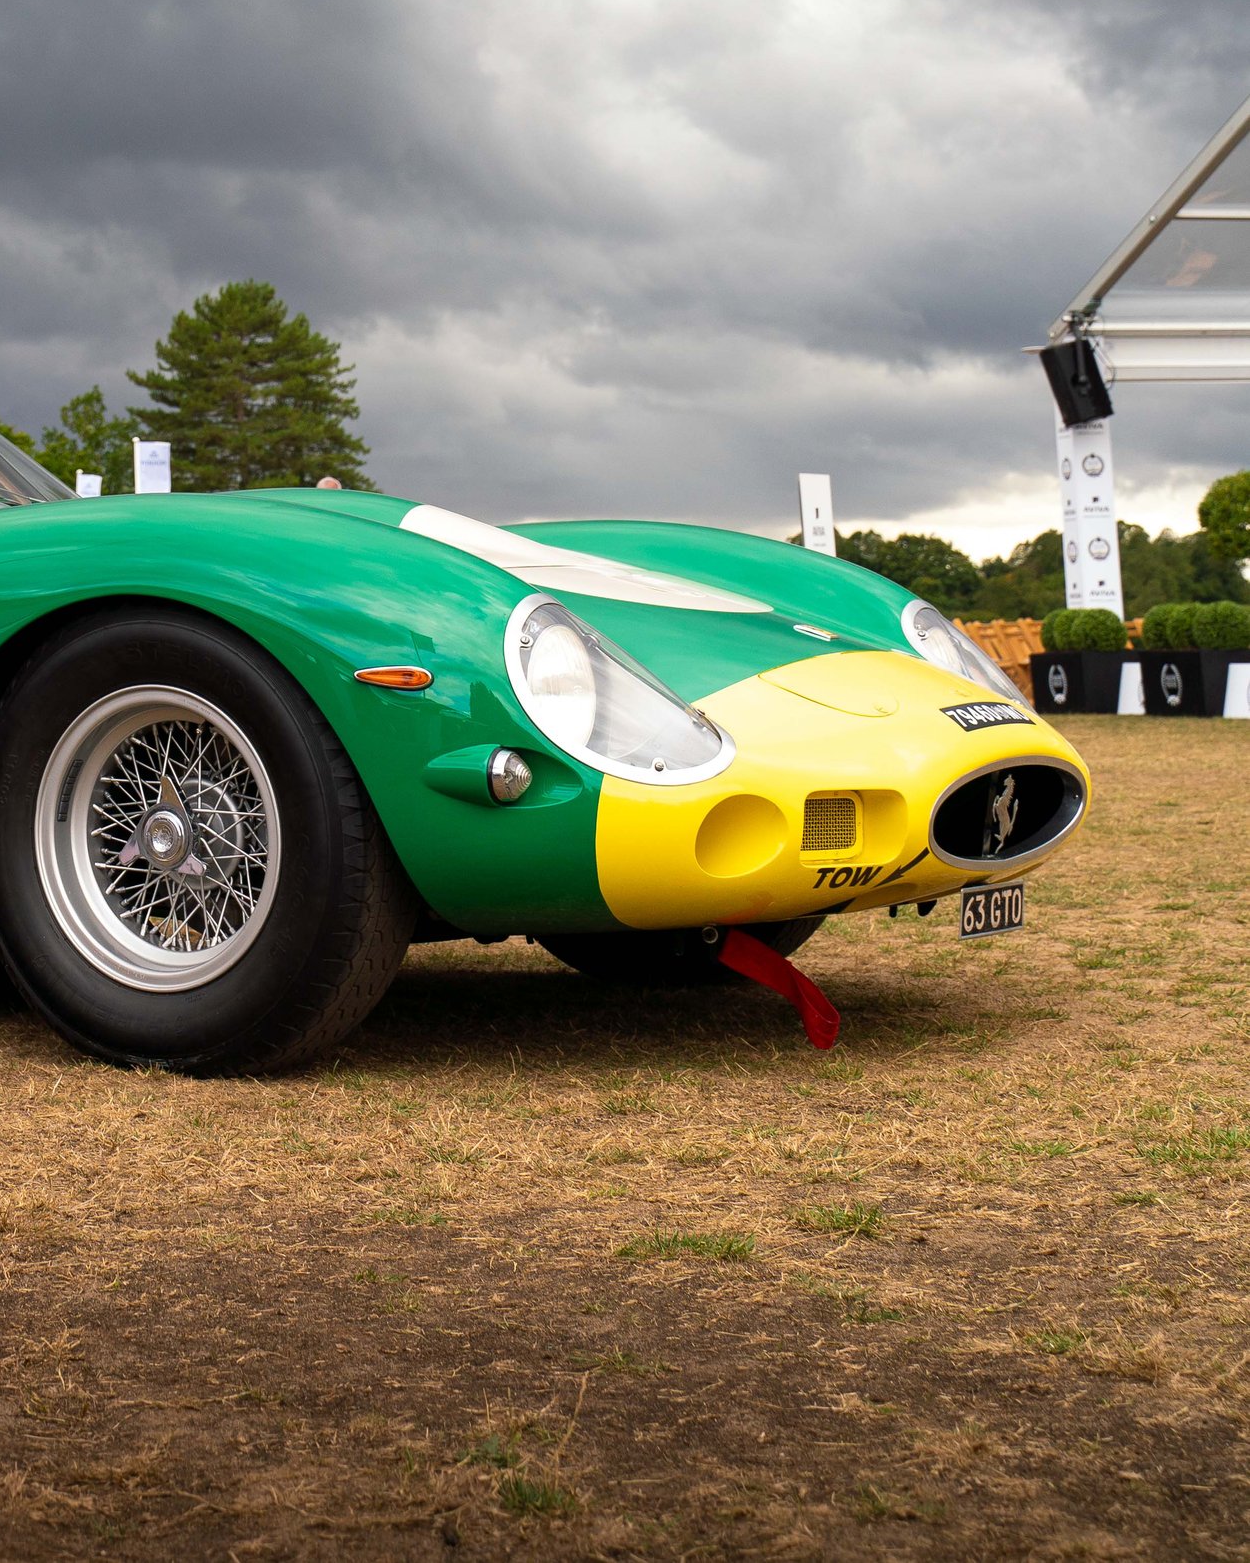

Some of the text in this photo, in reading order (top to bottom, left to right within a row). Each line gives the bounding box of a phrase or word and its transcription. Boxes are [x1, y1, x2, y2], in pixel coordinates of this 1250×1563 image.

[945, 704, 1002, 727] 79460
[813, 866, 883, 889] TOW
[963, 887, 1022, 933] 63 GTO
